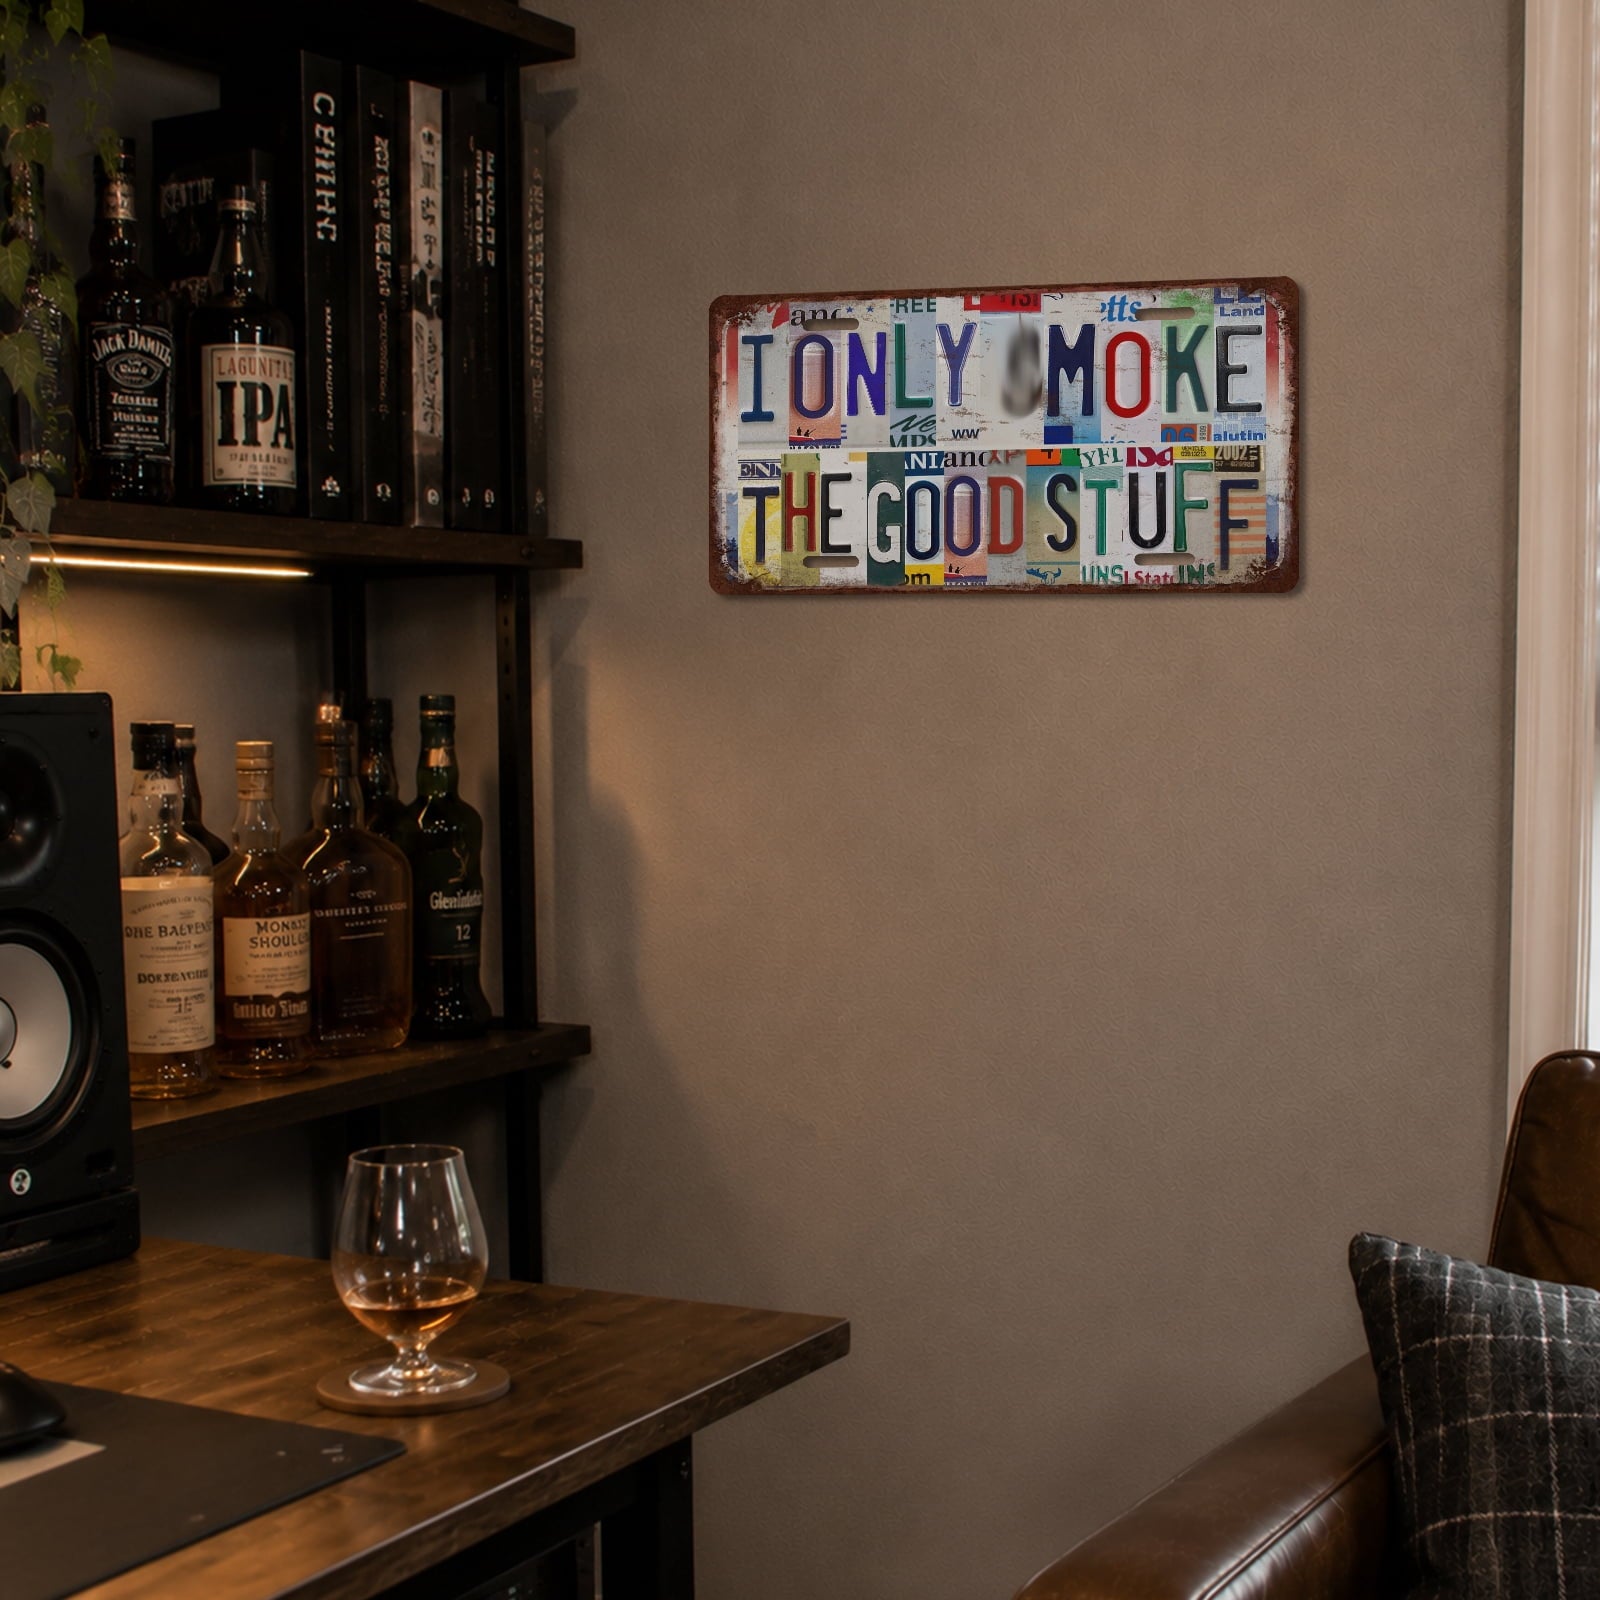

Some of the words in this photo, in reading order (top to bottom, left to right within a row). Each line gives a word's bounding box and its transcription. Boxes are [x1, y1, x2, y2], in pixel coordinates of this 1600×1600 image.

[890, 297, 937, 314] REE
[1219, 305, 1265, 316] Land
[92, 332, 127, 362] JACK
[741, 334, 775, 422] I
[793, 322, 978, 419] ONLY
[1001, 322, 1263, 419] MOKE
[216, 381, 294, 450] IPA
[904, 452, 945, 469] NI
[1215, 445, 1248, 461] 2002
[742, 472, 853, 566] THE
[867, 474, 1024, 564] GOOD
[1045, 462, 1260, 571] STUFF
[455, 923, 472, 942] 12
